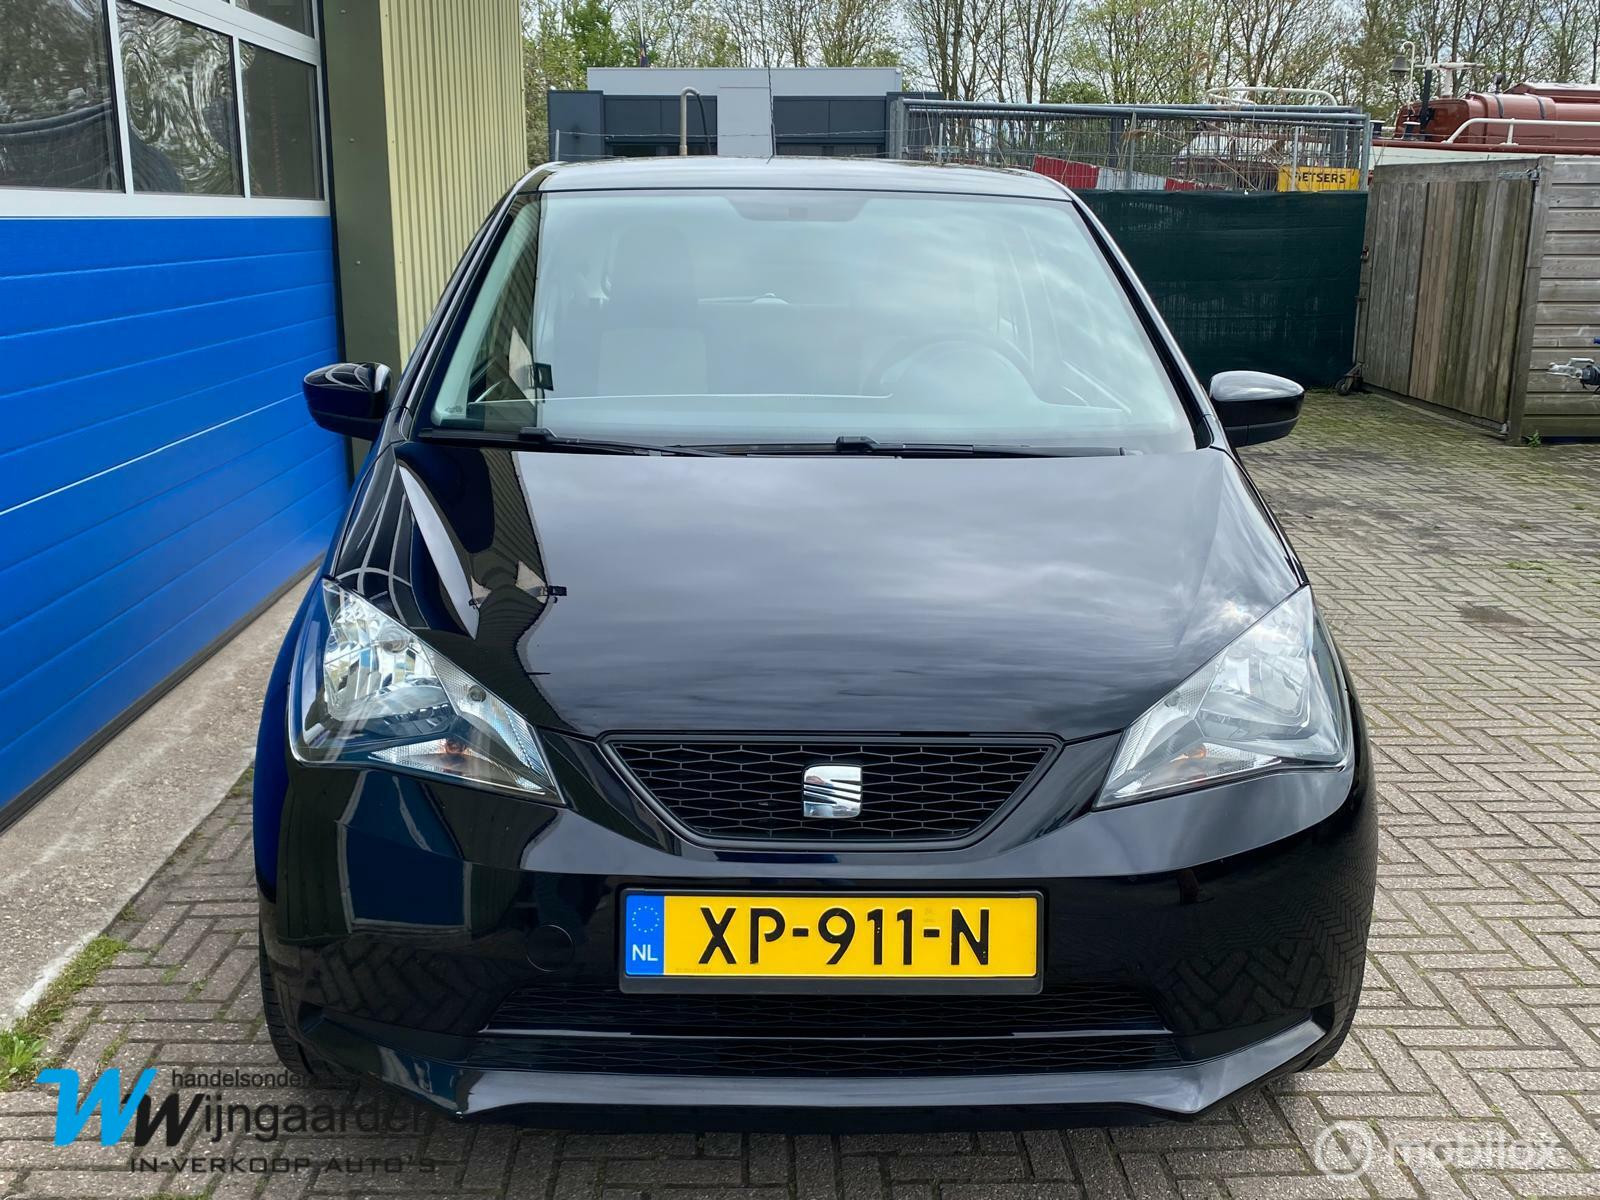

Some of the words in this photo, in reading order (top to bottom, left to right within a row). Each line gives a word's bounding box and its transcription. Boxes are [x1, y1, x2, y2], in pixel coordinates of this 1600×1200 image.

[1294, 172, 1346, 183] IETSERS
[698, 907, 990, 966] XP-911-N
[632, 944, 658, 962] NL
